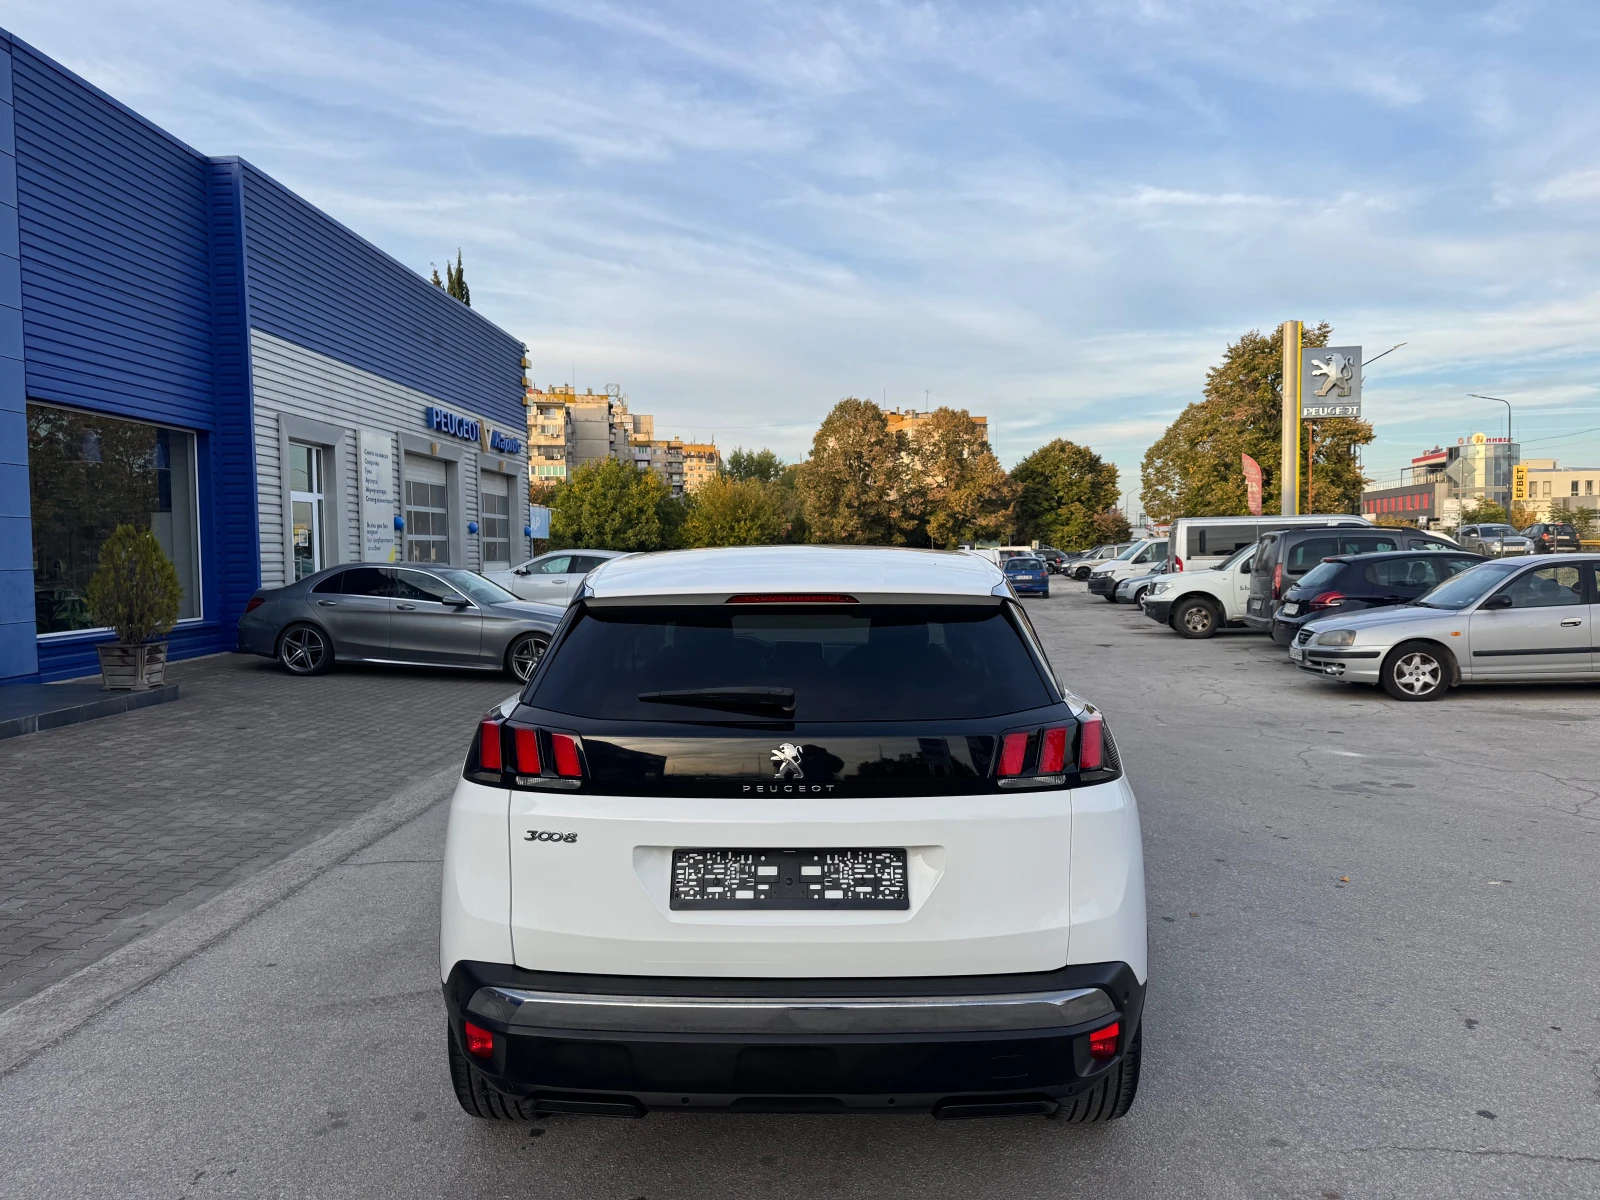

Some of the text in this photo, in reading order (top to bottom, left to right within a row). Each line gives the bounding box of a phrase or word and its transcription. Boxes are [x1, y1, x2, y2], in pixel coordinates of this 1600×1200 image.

[1303, 406, 1360, 416] PEUGEOT
[431, 407, 480, 441] PEUGEOT
[1516, 467, 1524, 498] EFBET
[742, 784, 835, 793] PEUGEOT
[523, 830, 578, 843] 3008
